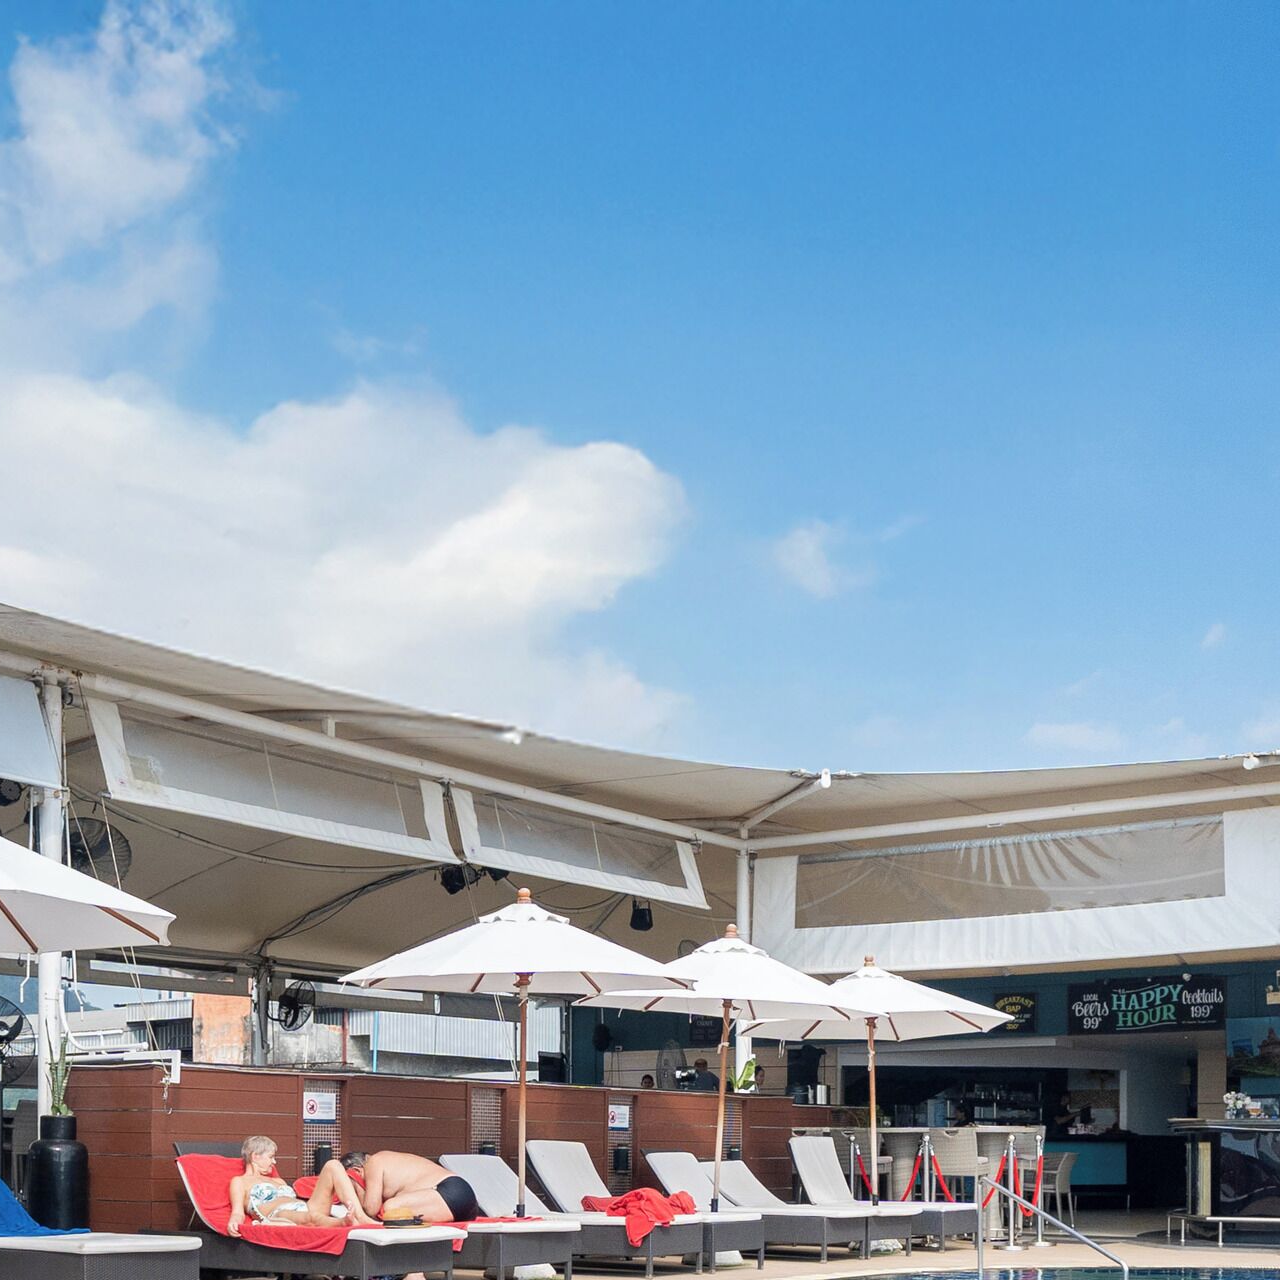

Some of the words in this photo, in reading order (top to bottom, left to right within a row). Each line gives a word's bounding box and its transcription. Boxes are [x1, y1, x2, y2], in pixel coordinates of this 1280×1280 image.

[1083, 993, 1099, 1002] LOCAL
[1111, 984, 1184, 1011] HAPPY
[1182, 988, 1224, 1005] Cocktails
[1071, 1001, 1109, 1017] Beers
[1115, 1004, 1177, 1027] HOUR
